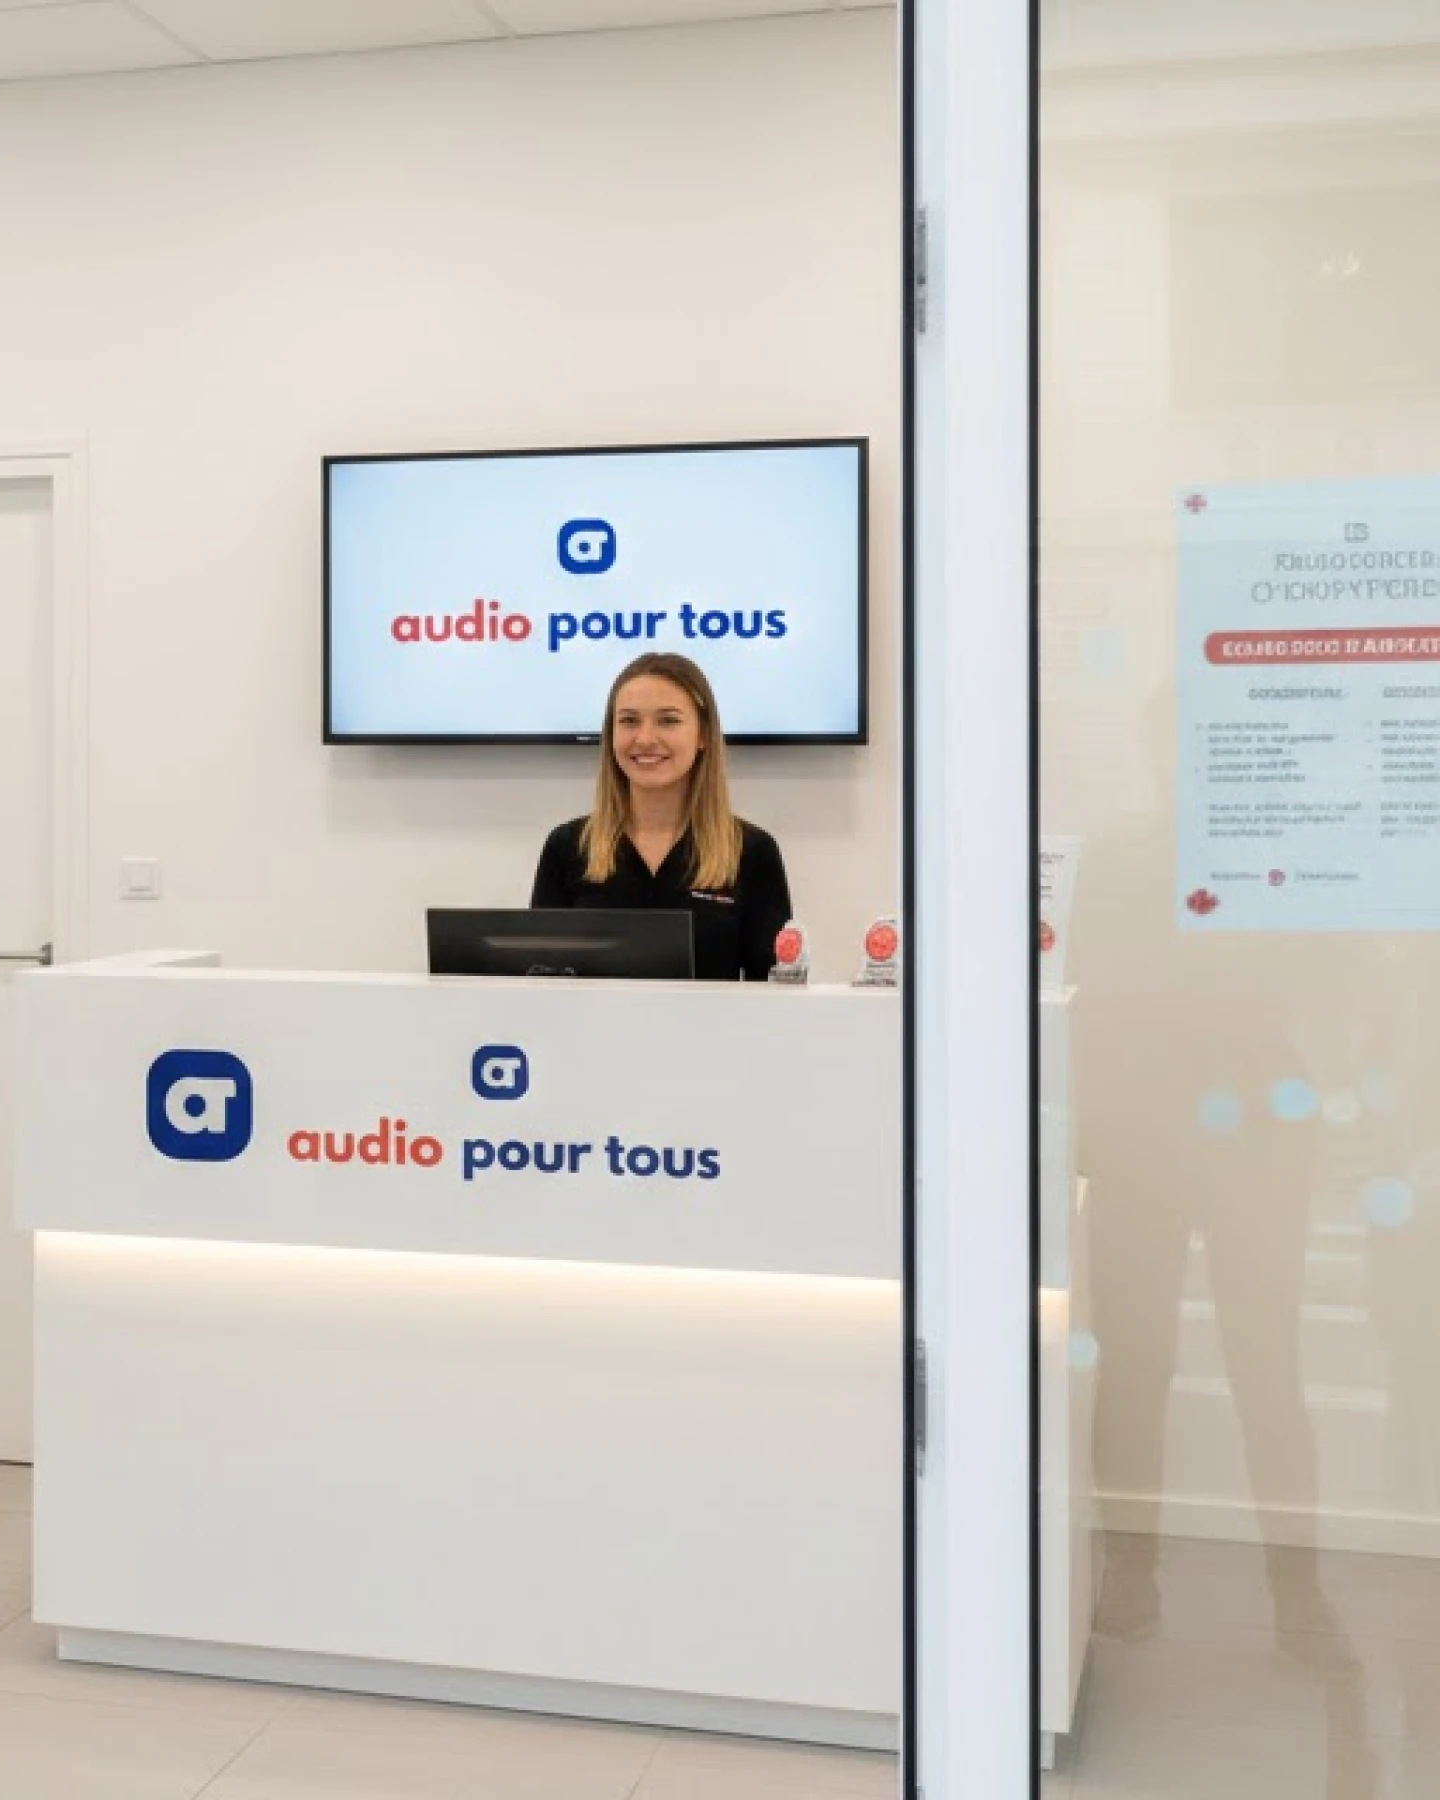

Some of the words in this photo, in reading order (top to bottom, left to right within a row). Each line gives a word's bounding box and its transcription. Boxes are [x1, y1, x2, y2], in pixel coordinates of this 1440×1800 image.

[392, 600, 531, 643] audio
[549, 611, 666, 652] pour
[680, 603, 787, 638] tous
[288, 1118, 442, 1166] audio
[464, 1139, 592, 1180] pour
[605, 1136, 720, 1179] tous
